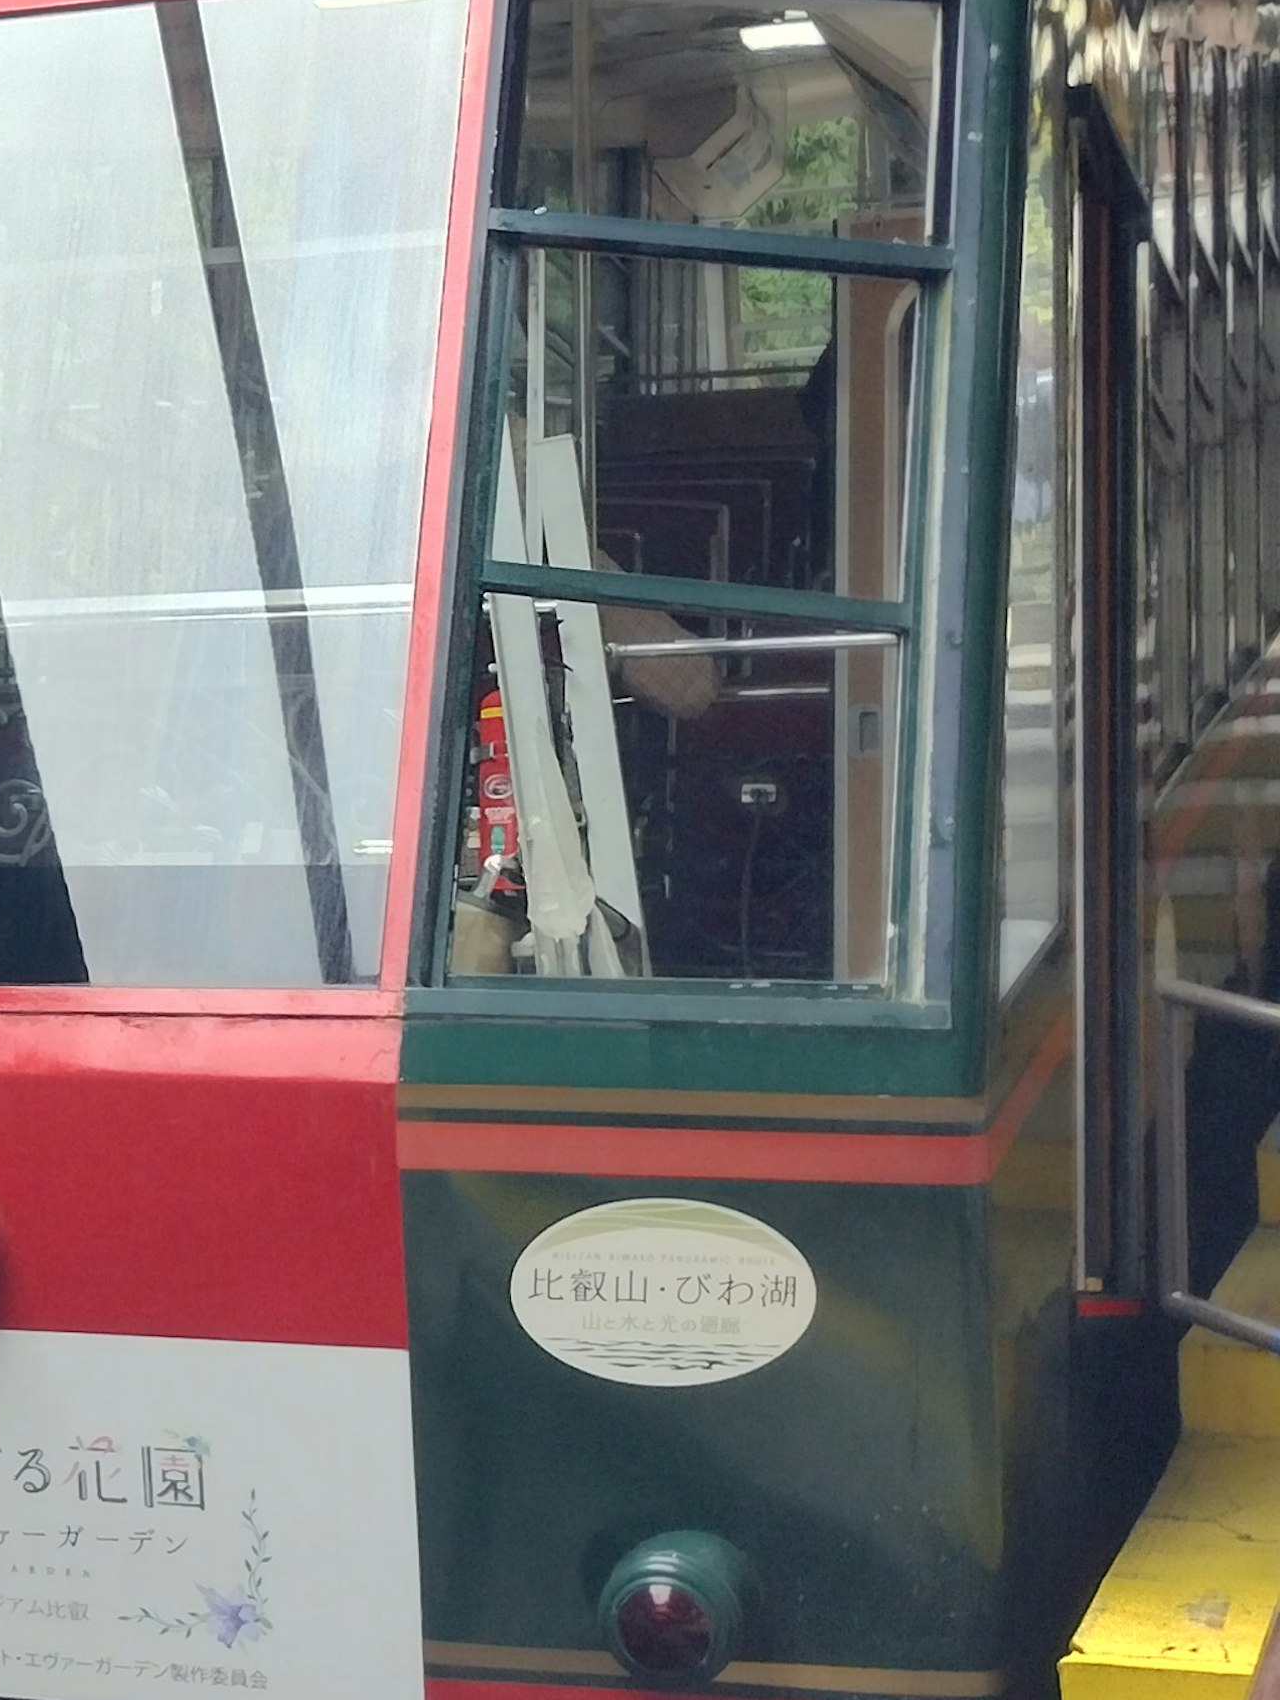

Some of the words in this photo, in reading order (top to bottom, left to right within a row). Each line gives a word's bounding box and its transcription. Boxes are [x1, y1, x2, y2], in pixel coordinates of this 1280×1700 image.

[527, 1266, 798, 1308] 比叡山・びわ湖
